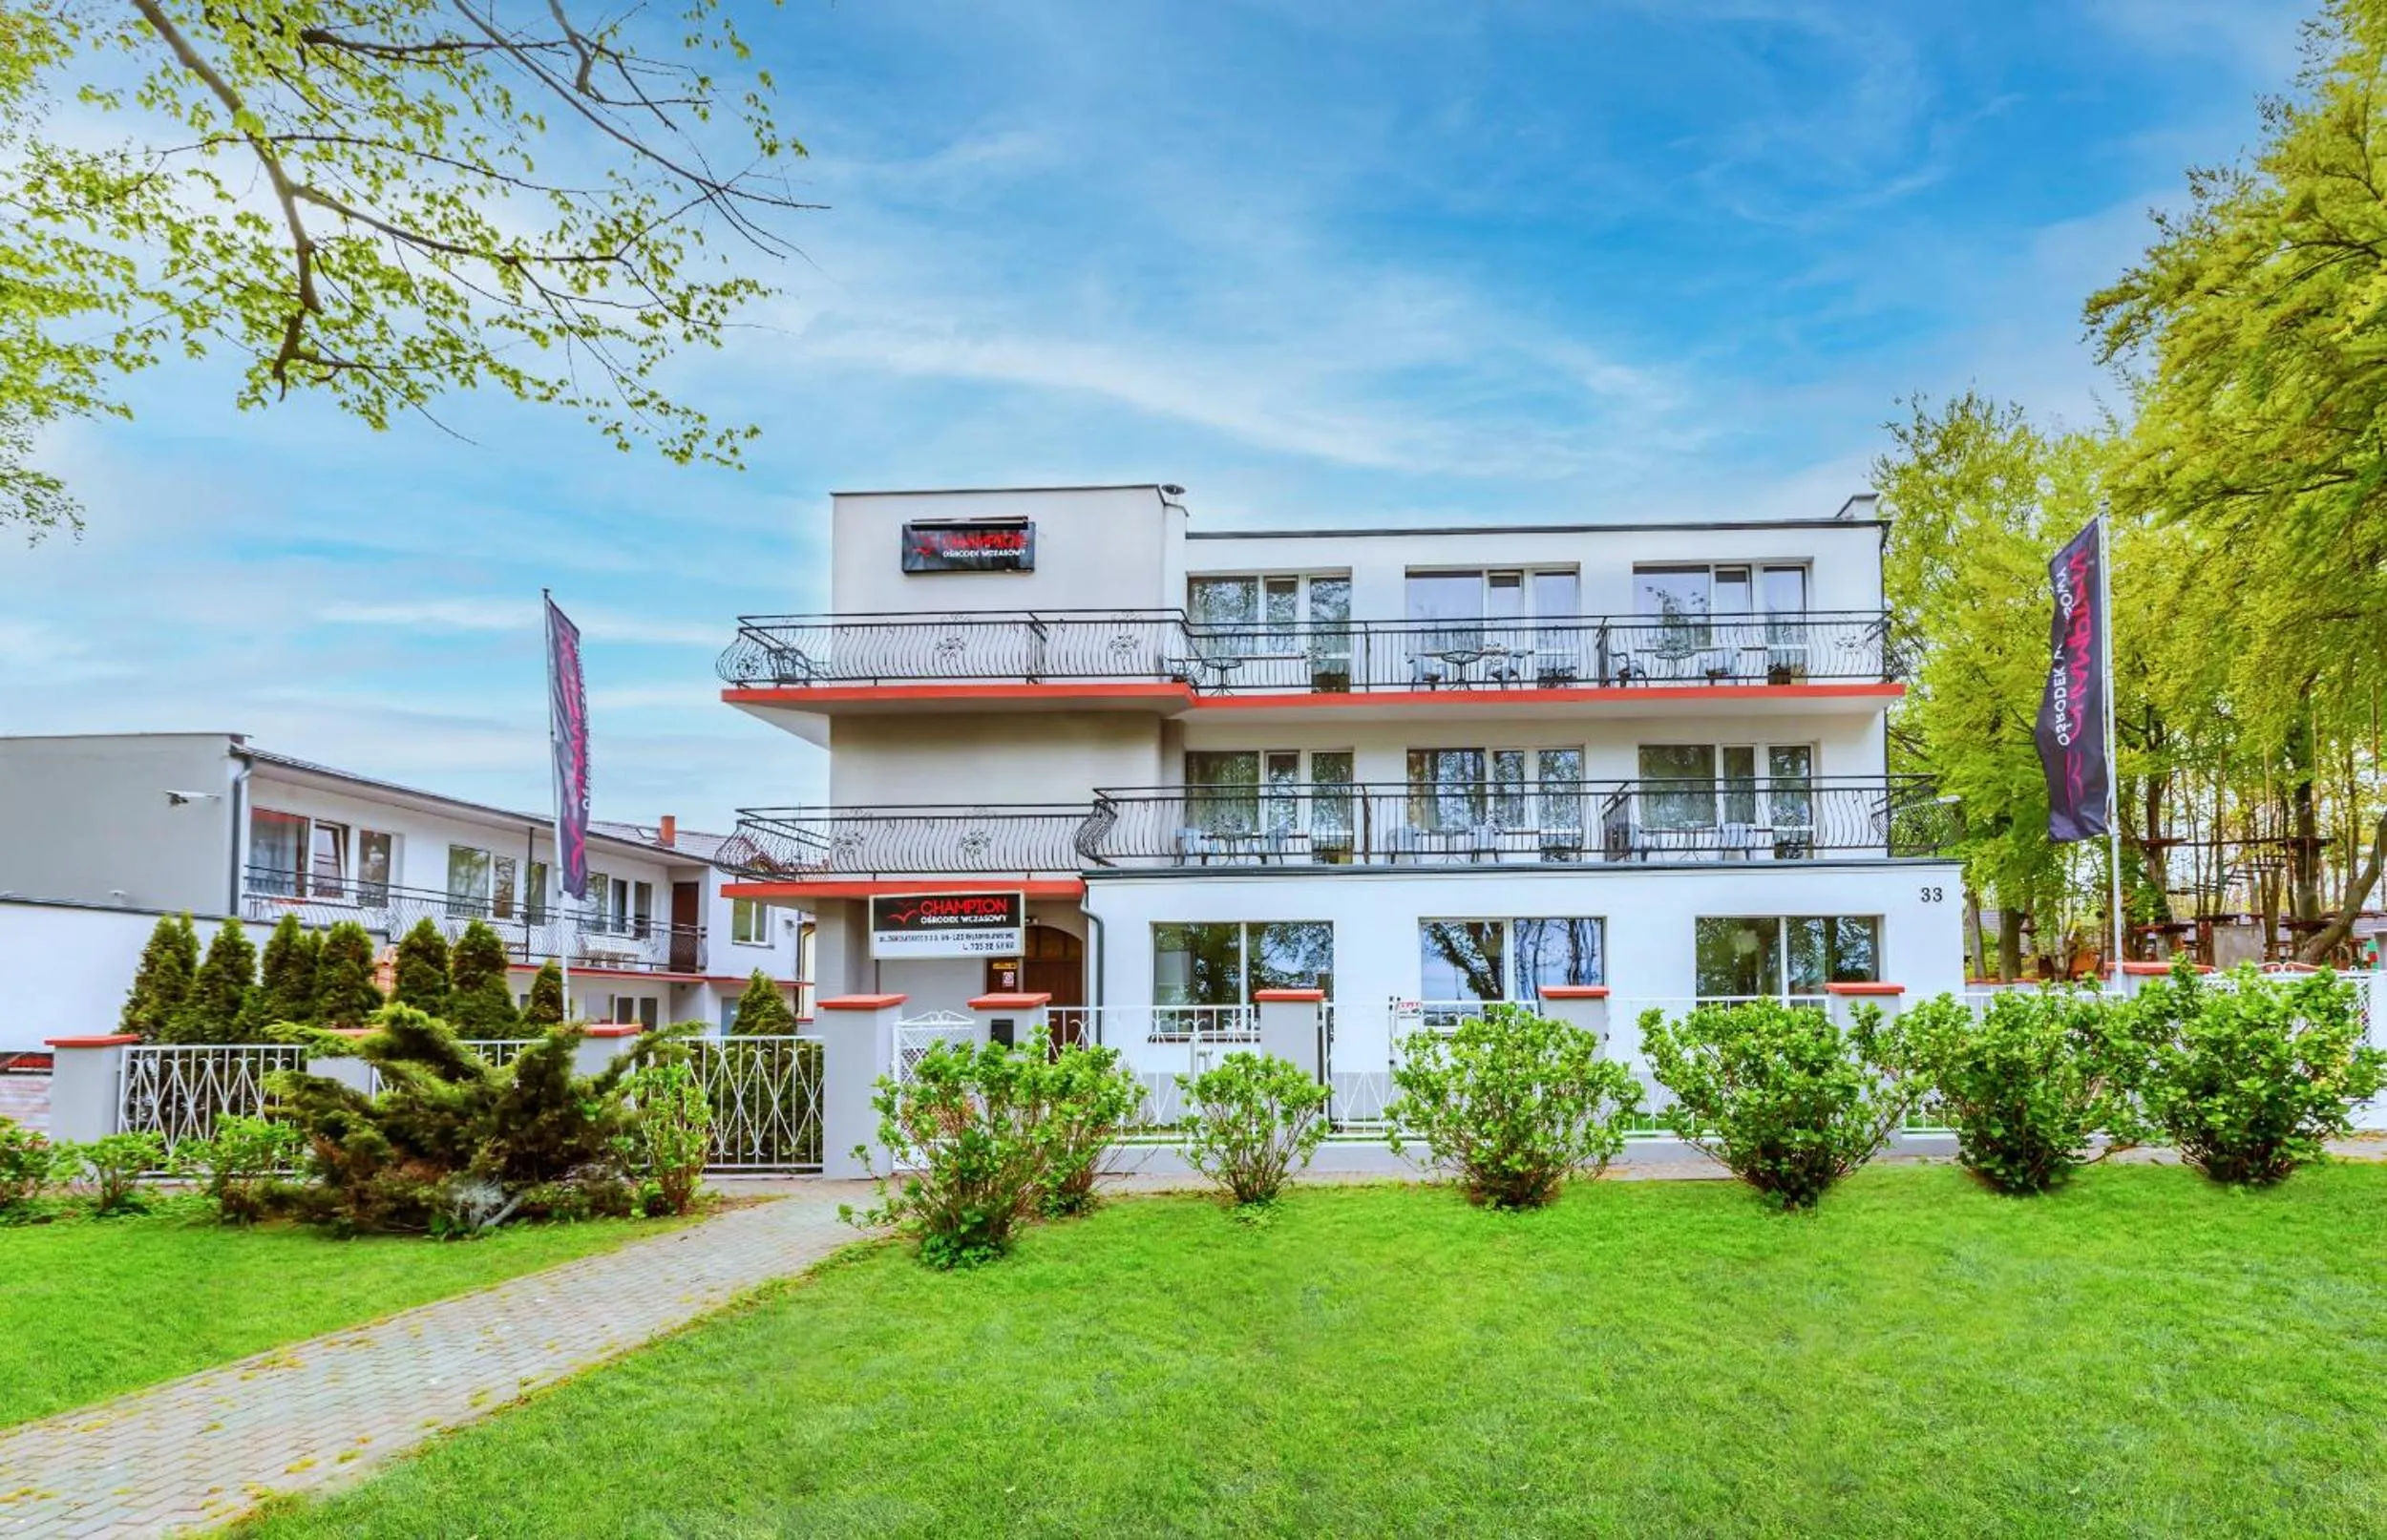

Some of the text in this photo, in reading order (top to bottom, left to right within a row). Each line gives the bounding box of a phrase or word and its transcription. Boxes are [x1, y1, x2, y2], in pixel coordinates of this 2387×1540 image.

[1921, 887, 1943, 902] 33
[920, 898, 1007, 915] CHAMPION
[961, 915, 1007, 923] WCZASOWY
